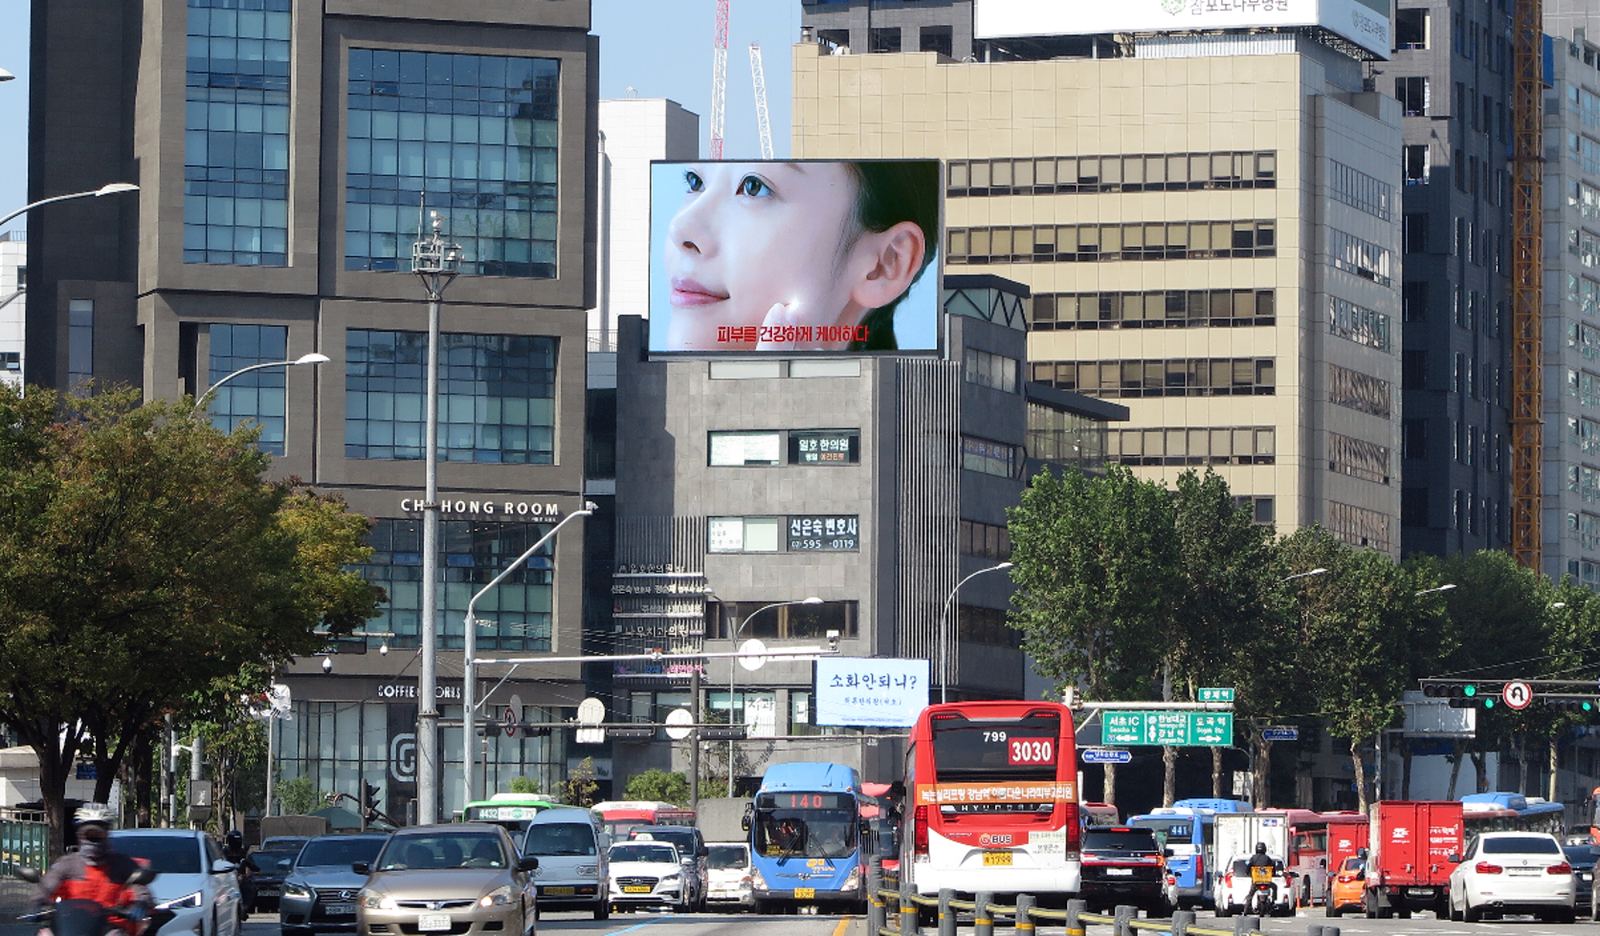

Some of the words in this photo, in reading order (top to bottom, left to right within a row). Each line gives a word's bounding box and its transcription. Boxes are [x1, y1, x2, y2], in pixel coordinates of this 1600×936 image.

[717, 326, 757, 342] 피부를
[760, 325, 812, 342] 건강하게
[816, 325, 869, 342] 케어하다
[820, 438, 849, 451] 한의원
[401, 499, 494, 514] CHHONG
[504, 502, 559, 515] ROOM
[791, 519, 823, 536] 신은숙
[825, 518, 857, 535] 변호사
[803, 540, 822, 549] 595
[830, 672, 918, 690] 소화안되니?
[983, 732, 1007, 742] 799
[1012, 742, 1051, 761] 3030
[790, 795, 823, 808] 140
[1171, 825, 1188, 835] 441
